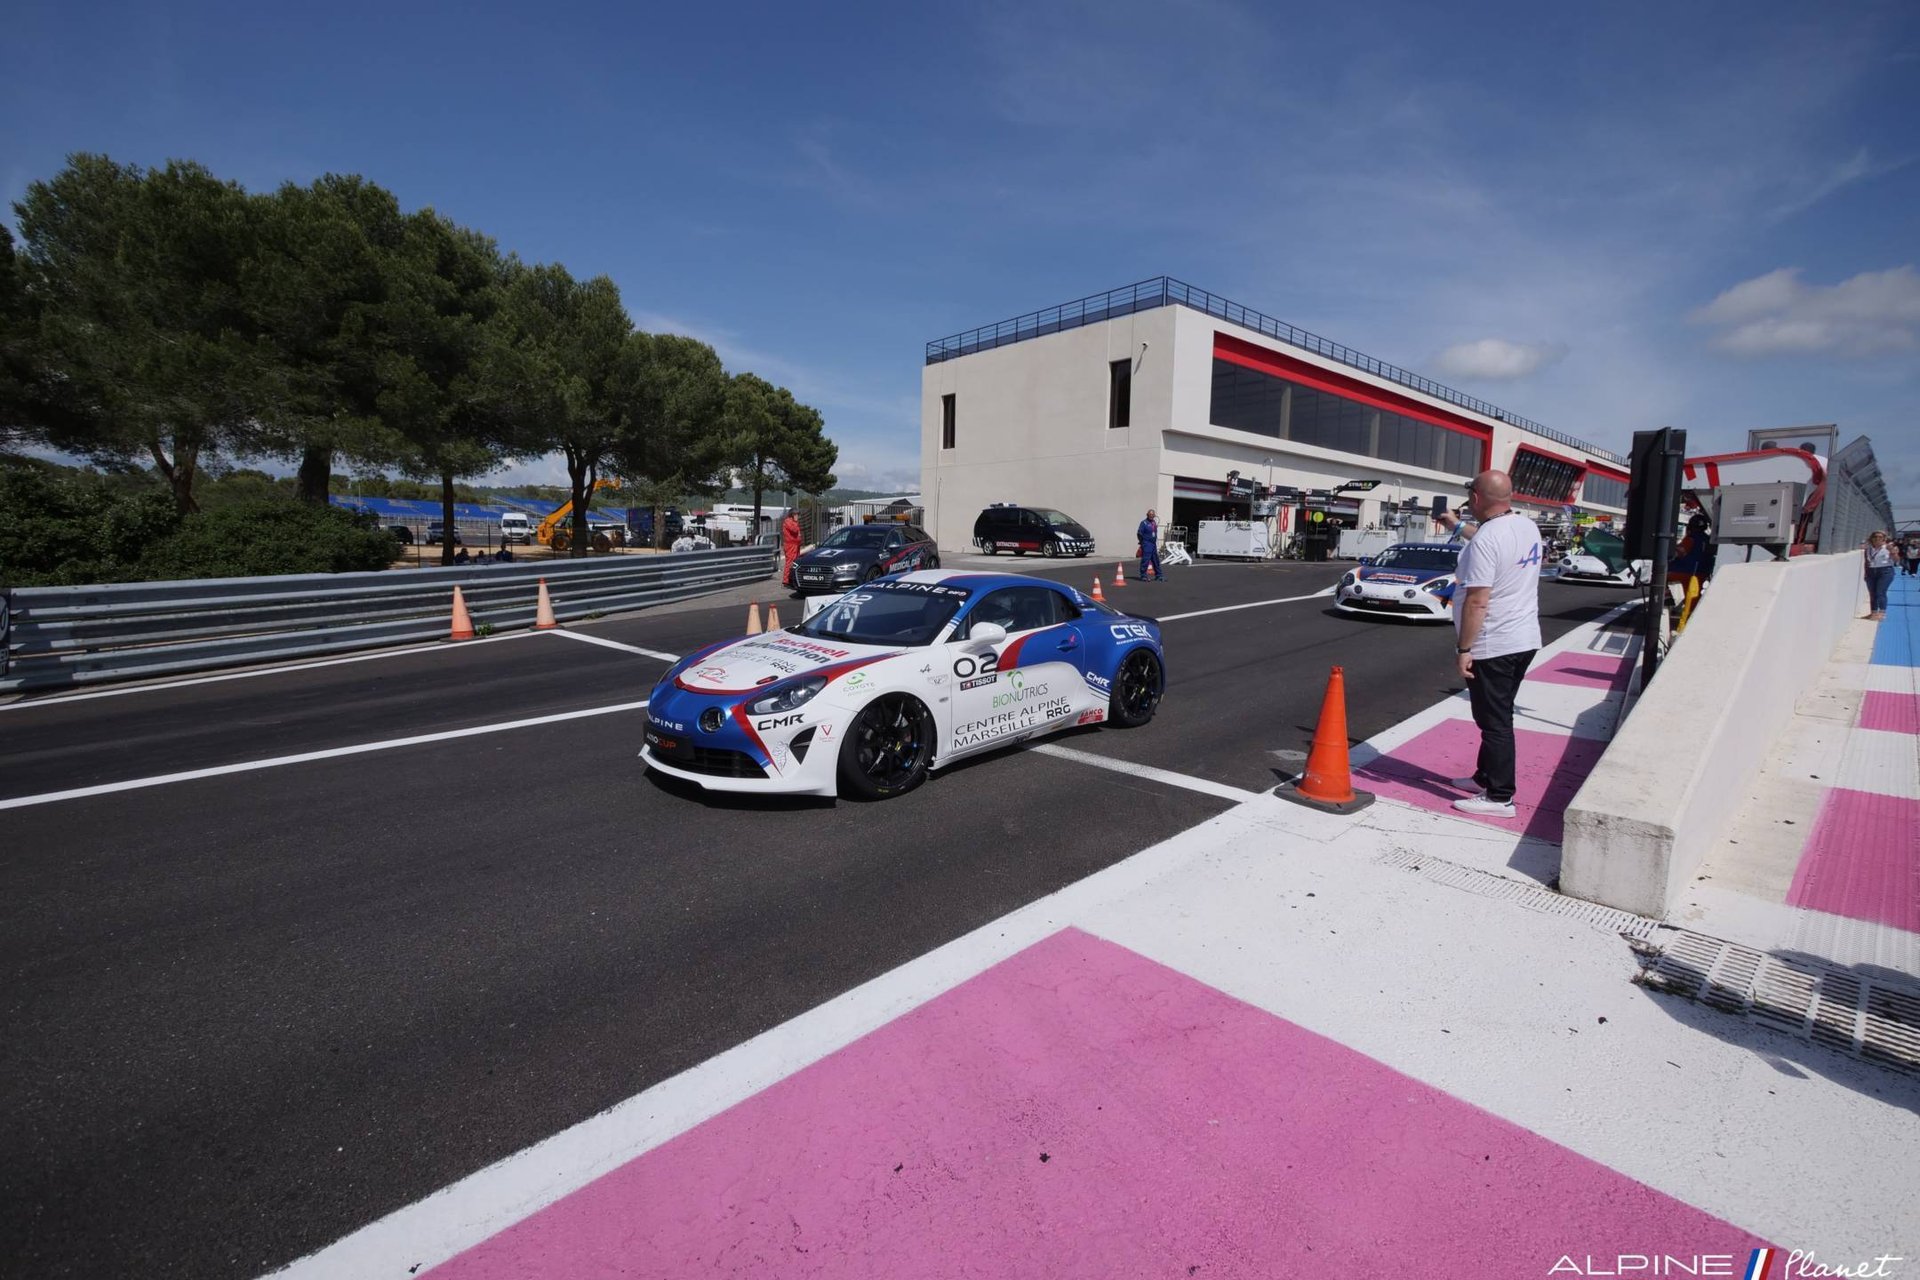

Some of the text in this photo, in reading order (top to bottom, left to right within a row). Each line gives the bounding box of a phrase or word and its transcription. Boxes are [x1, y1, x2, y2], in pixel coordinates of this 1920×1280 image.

[889, 560, 910, 572] MEDICAL
[875, 583, 949, 594] ALPINE
[1110, 624, 1153, 640] CTEK
[953, 652, 1002, 678] 02
[972, 674, 998, 688] TISSOT
[1086, 671, 1111, 687] CMR
[992, 682, 1050, 709] BIONUTRICS
[955, 696, 1068, 736] CENTRE ALPINE
[1046, 704, 1072, 720] RRG
[757, 713, 805, 731] CMR
[953, 717, 1037, 749] MARSEILLE
